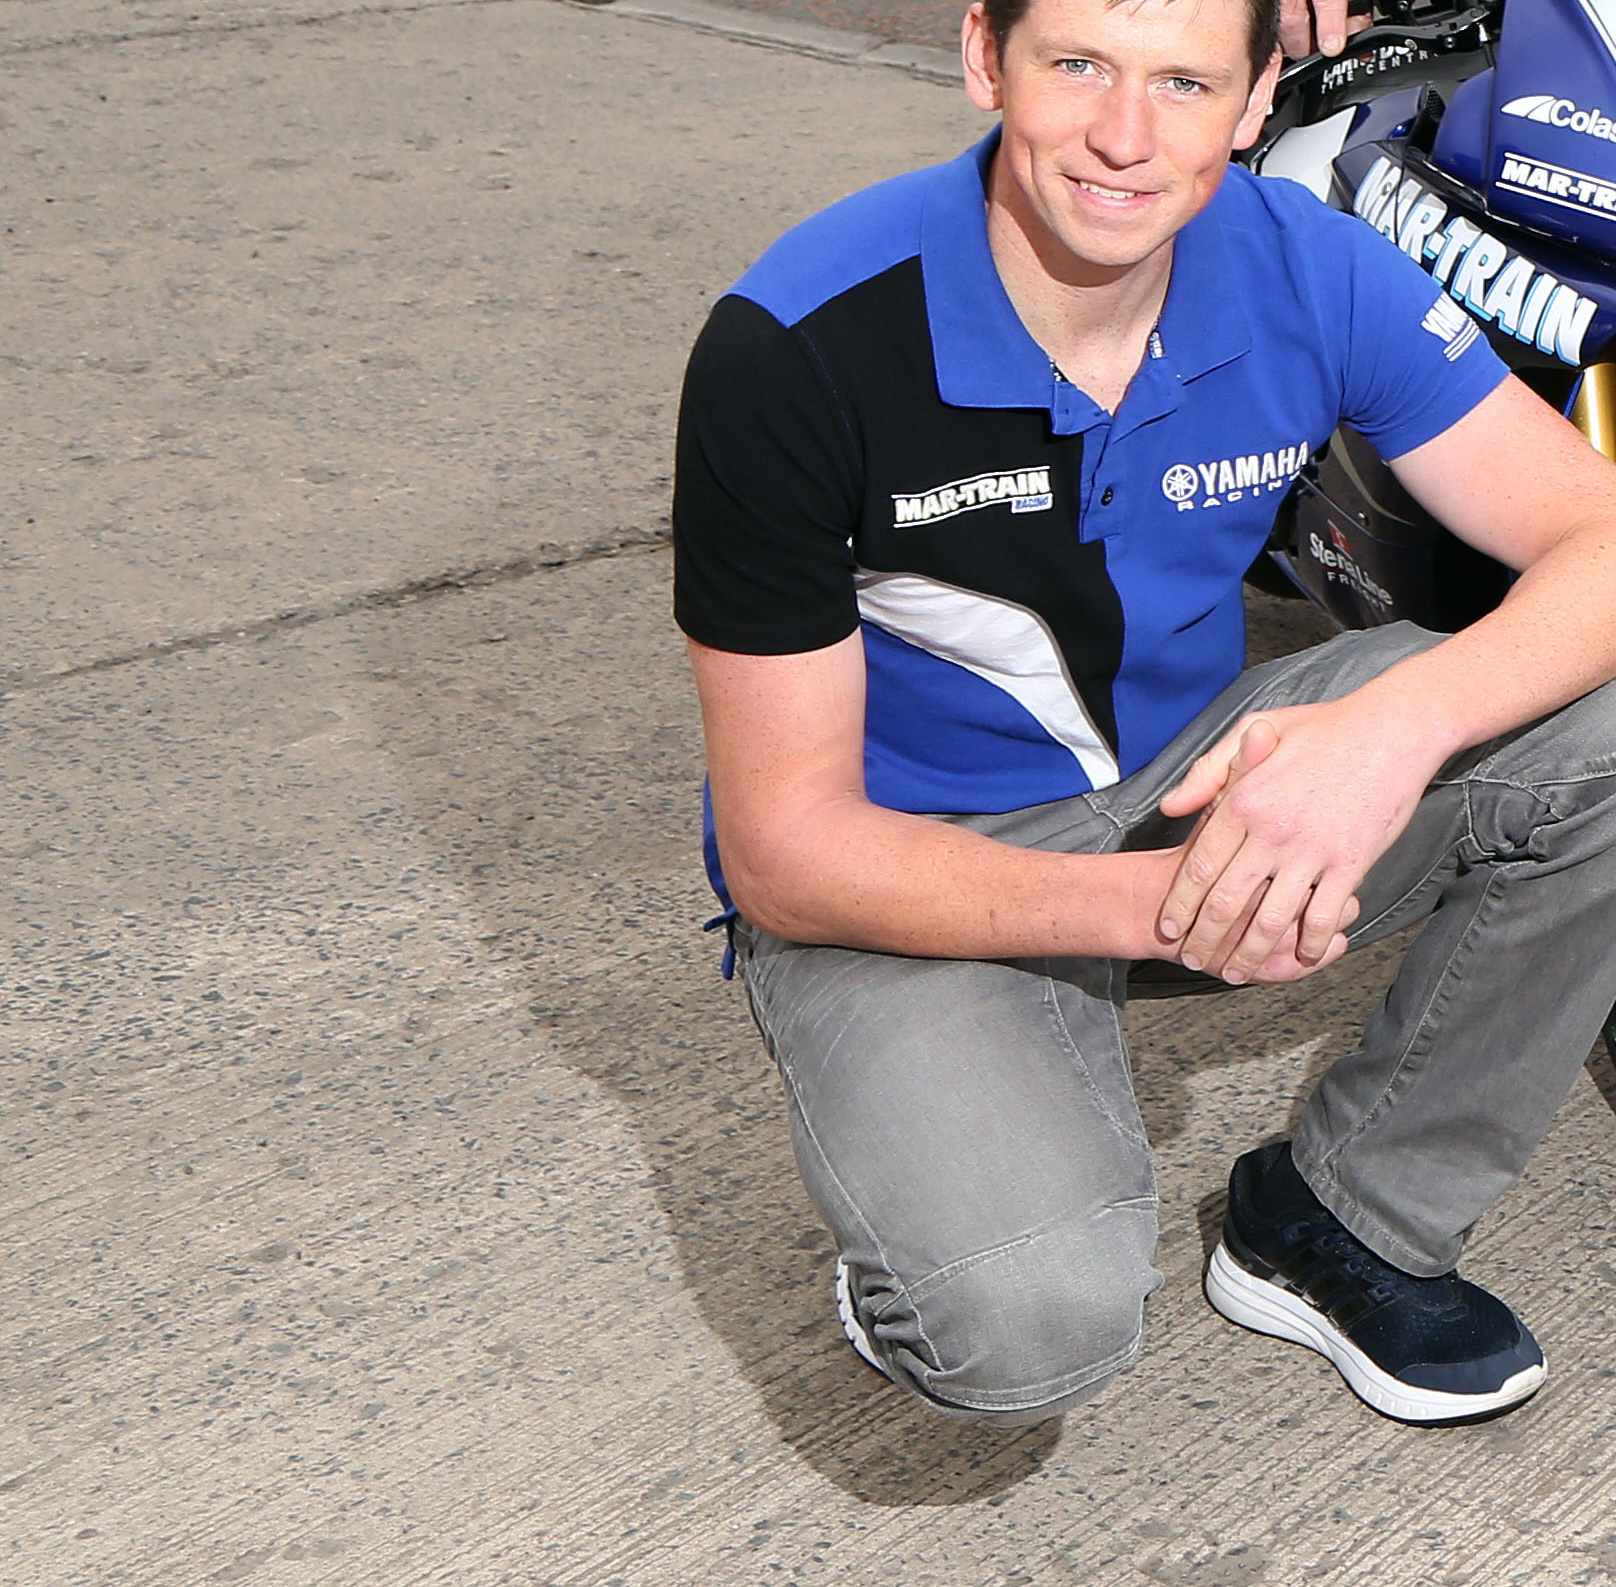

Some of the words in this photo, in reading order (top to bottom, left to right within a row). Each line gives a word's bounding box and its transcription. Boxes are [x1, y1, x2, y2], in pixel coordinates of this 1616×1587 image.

[1353, 156, 1598, 367] MAR-TRAIN
[1197, 440, 1309, 496] YAMAHA
[895, 471, 1051, 523] MAR-TRAIN
